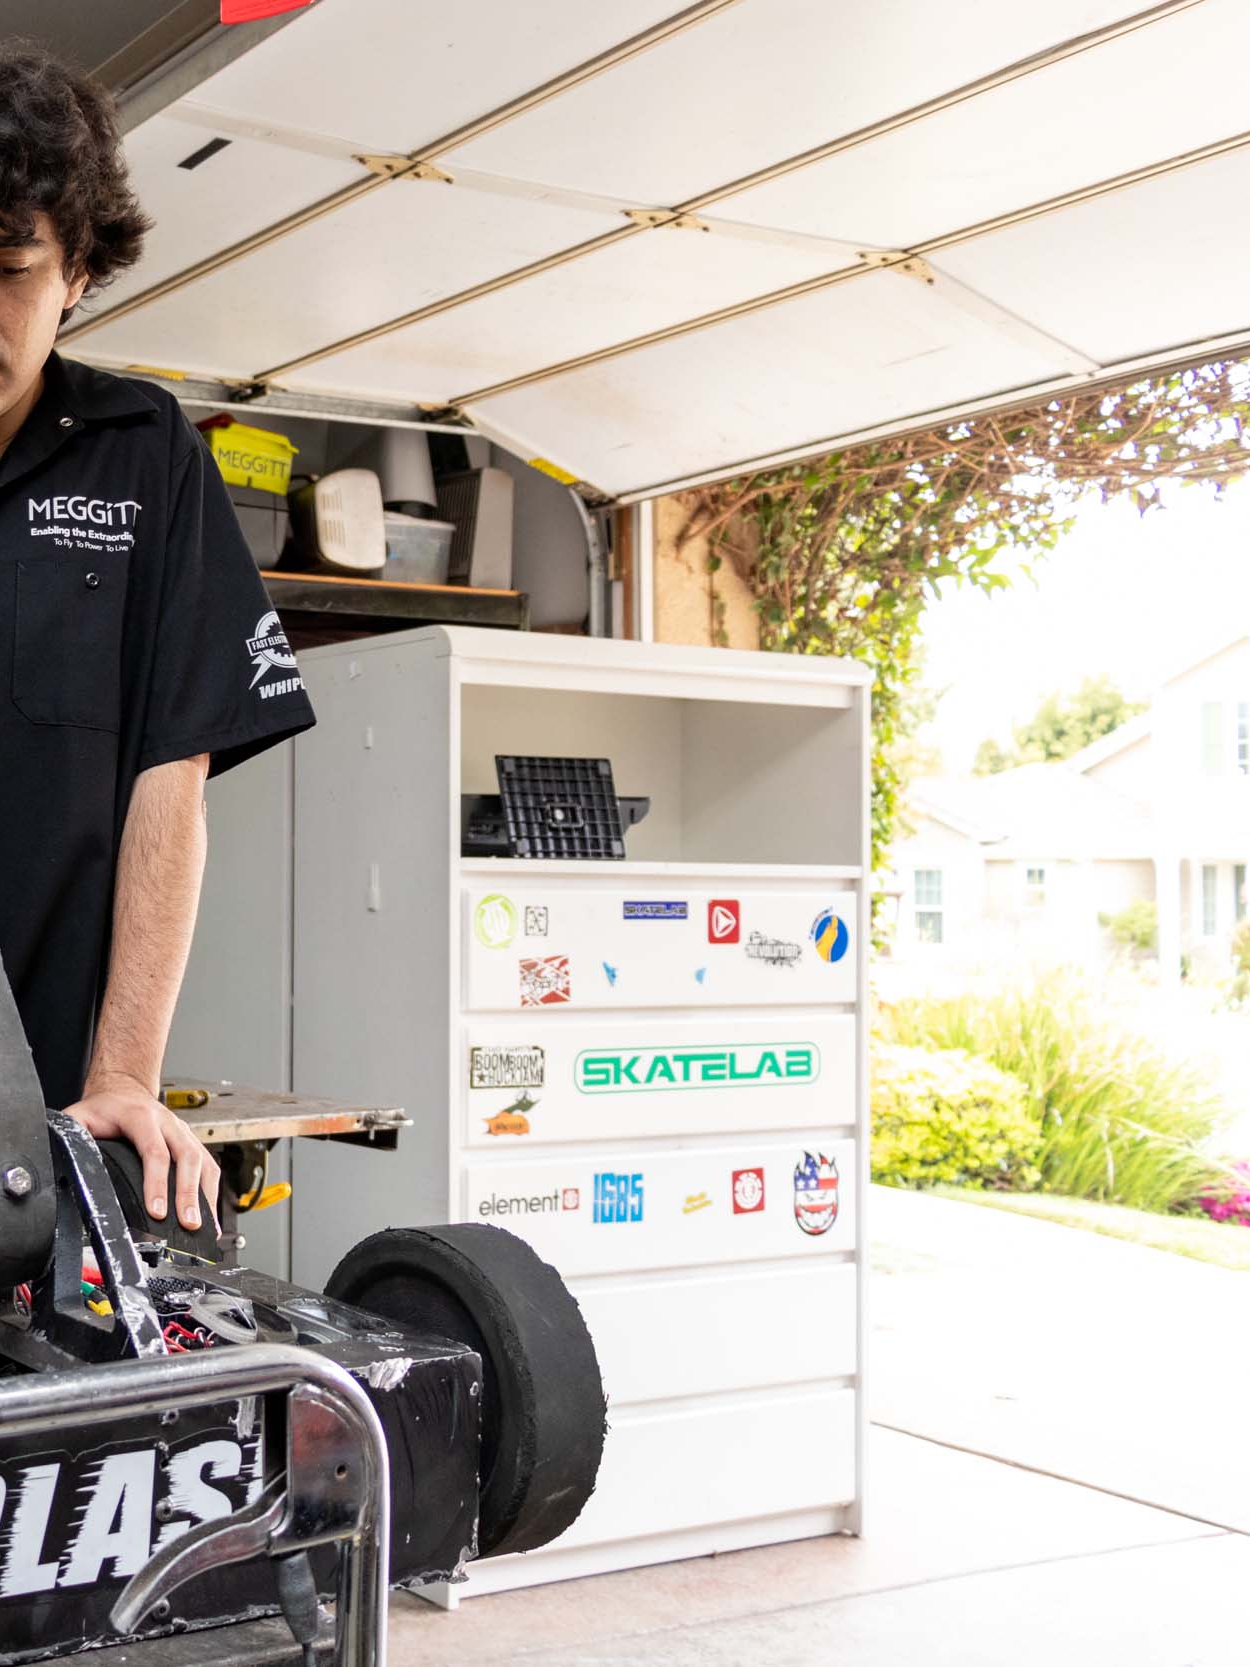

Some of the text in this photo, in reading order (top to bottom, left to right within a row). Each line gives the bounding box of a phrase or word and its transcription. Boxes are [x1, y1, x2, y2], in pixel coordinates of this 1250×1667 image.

[31, 525, 70, 538] Enabling
[72, 528, 86, 538] the
[53, 538, 129, 552] To Fly To Power To Live
[252, 639, 268, 651] FAST
[583, 1050, 812, 1086] SKATELAB
[479, 1188, 560, 1215] element
